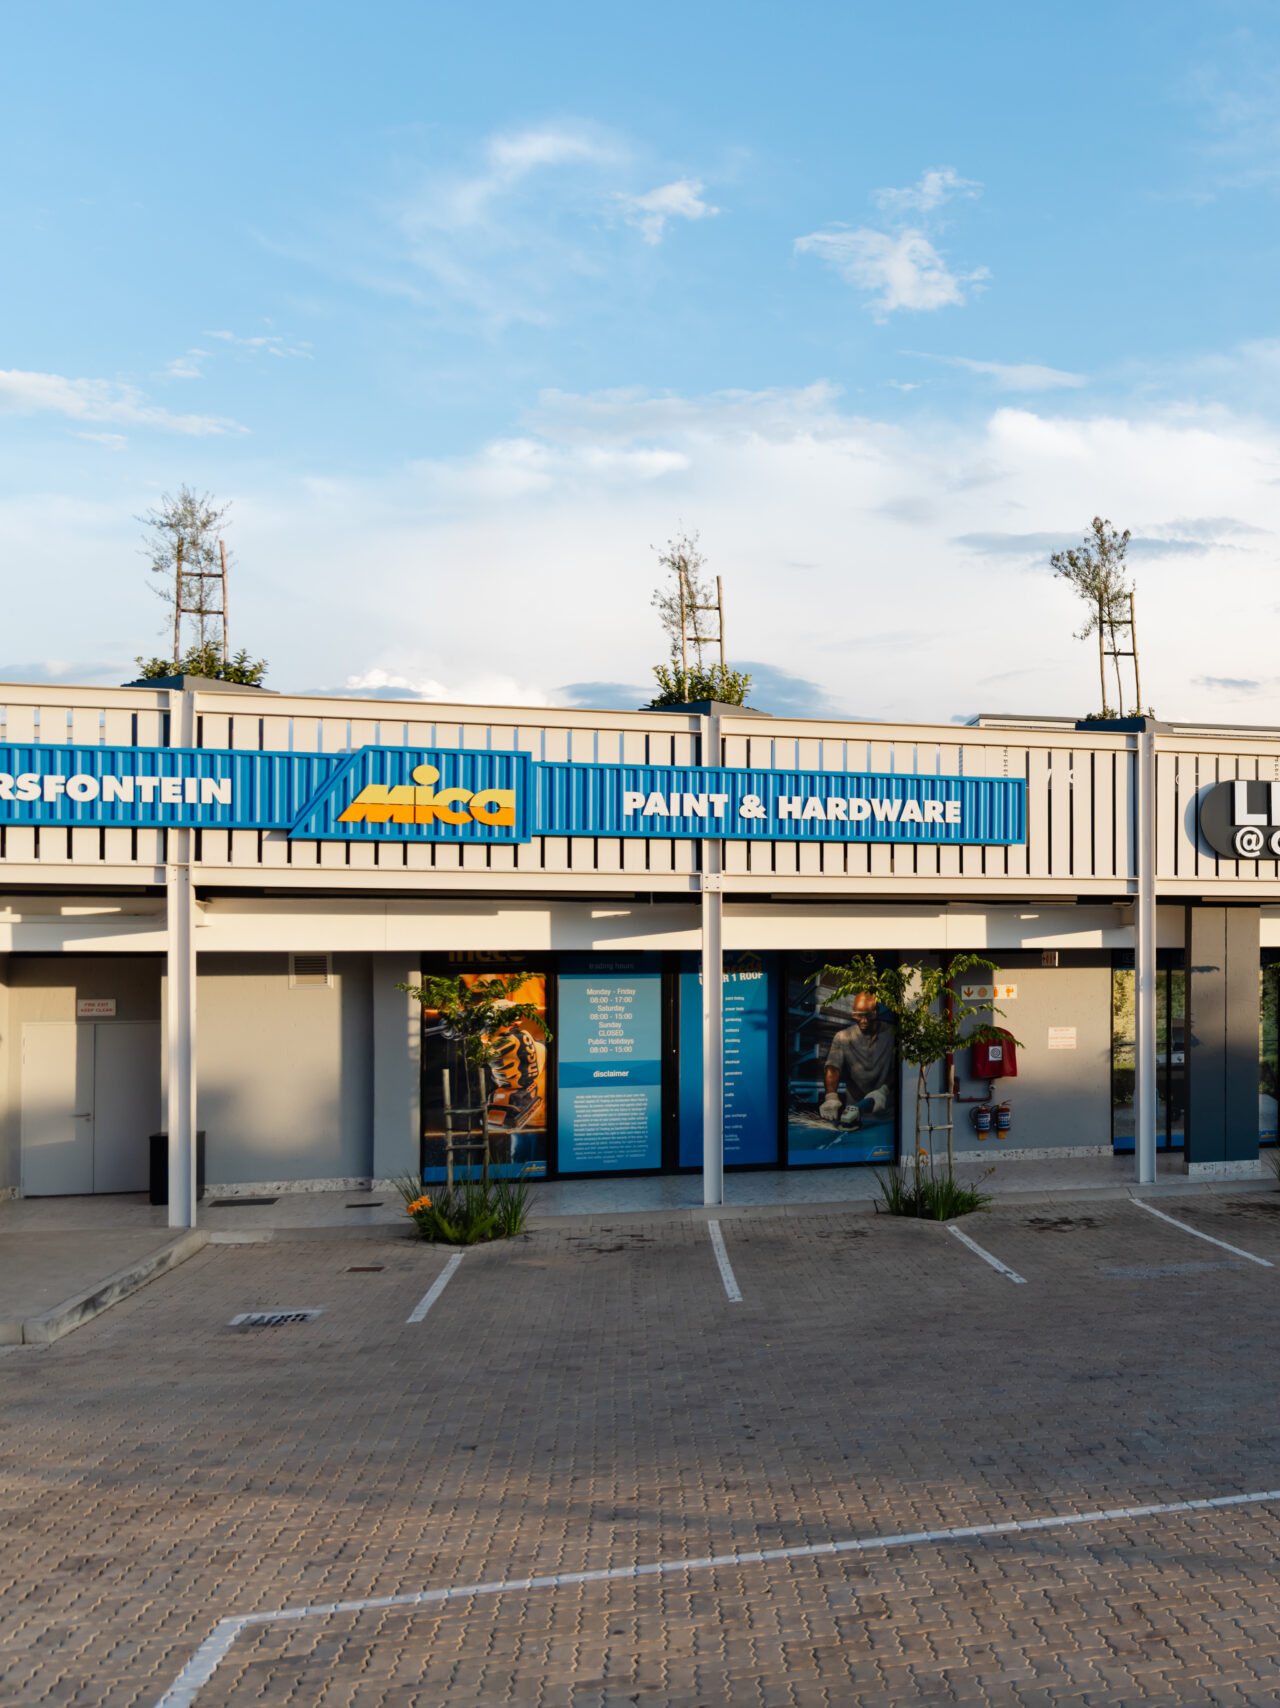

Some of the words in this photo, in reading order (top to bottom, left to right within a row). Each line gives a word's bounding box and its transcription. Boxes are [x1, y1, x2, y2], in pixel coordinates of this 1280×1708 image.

[623, 791, 728, 817] PAINT
[739, 794, 768, 819] &
[778, 796, 961, 824] HARDWARE
[1235, 826, 1264, 857] @
[586, 988, 611, 996] Monday
[617, 988, 636, 996] Friday
[598, 1021, 622, 1029] Sunday
[593, 1070, 629, 1078] disclaimer
